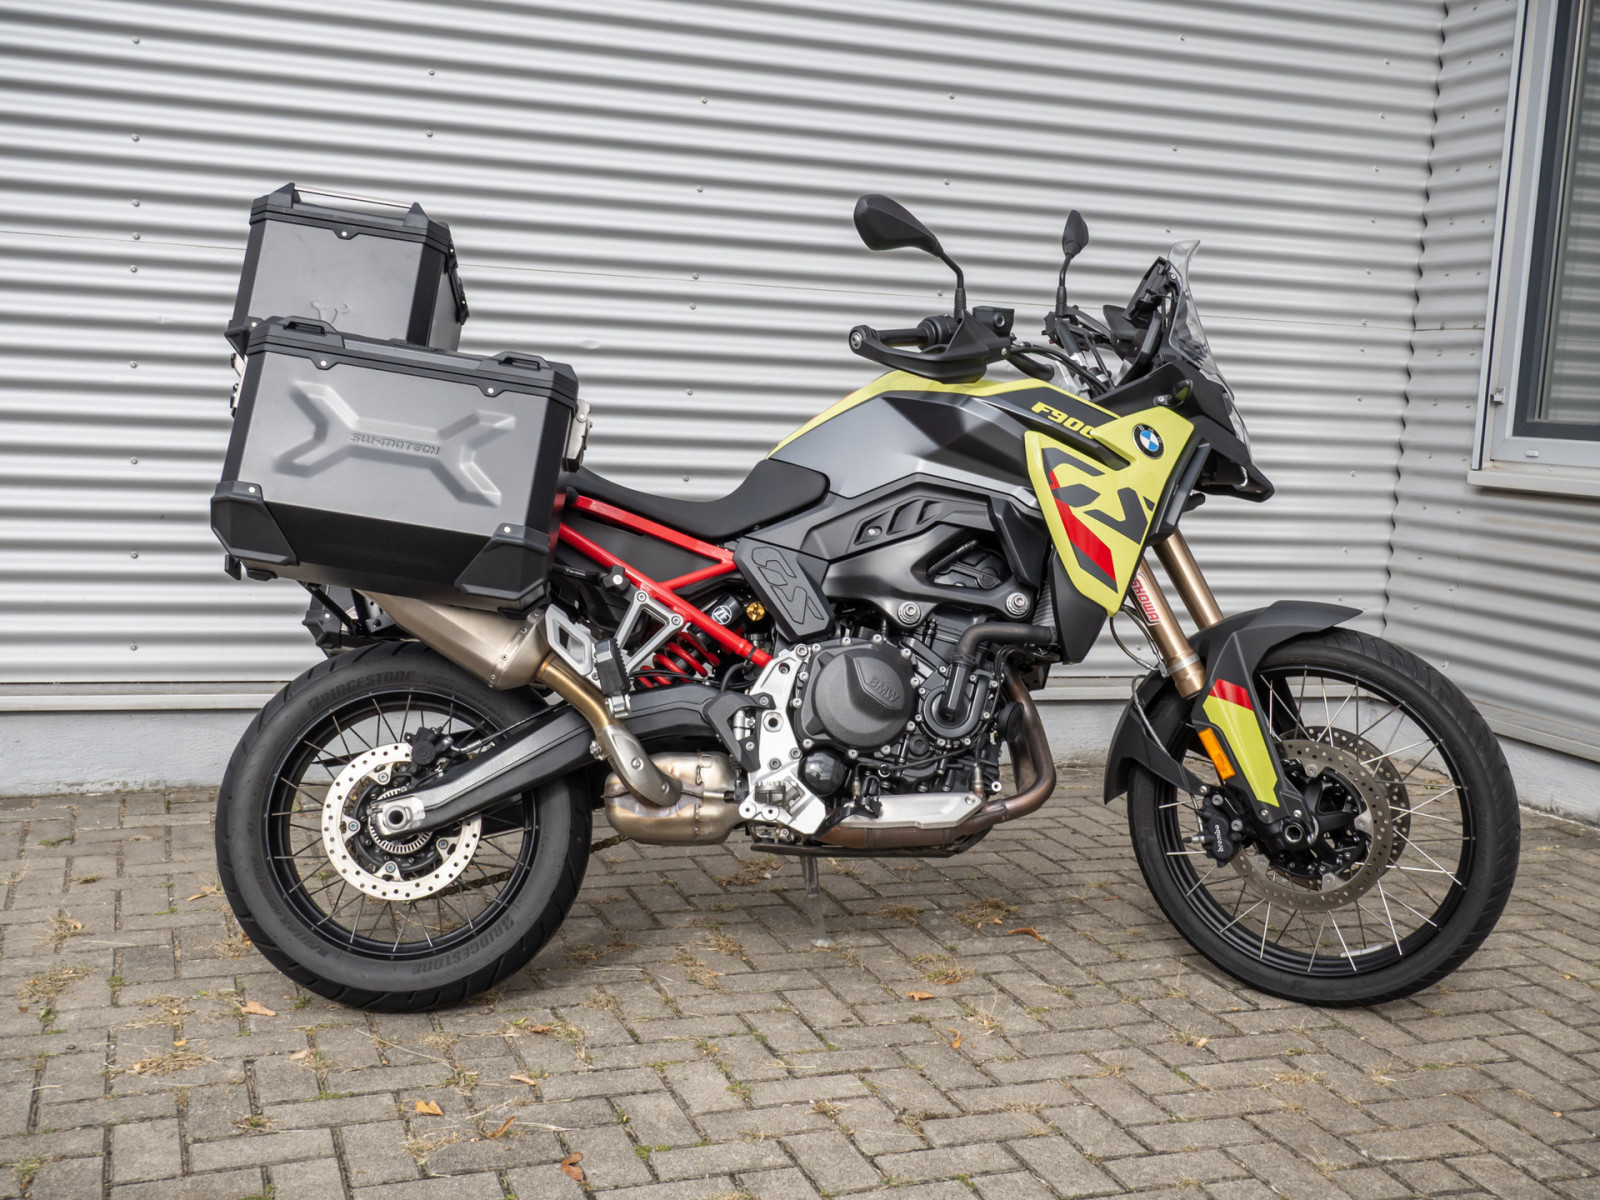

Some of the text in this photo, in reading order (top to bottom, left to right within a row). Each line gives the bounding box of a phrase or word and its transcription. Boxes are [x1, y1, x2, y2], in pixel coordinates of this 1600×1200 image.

[350, 432, 441, 455] SW-MOTECH
[752, 546, 825, 625] GS
[1132, 578, 1160, 621] SHOWA
[308, 670, 416, 710] BRIDGESTONE
[869, 676, 900, 703] BMW
[1214, 824, 1224, 852] brembo
[411, 914, 515, 975] BRIDGESTONE
